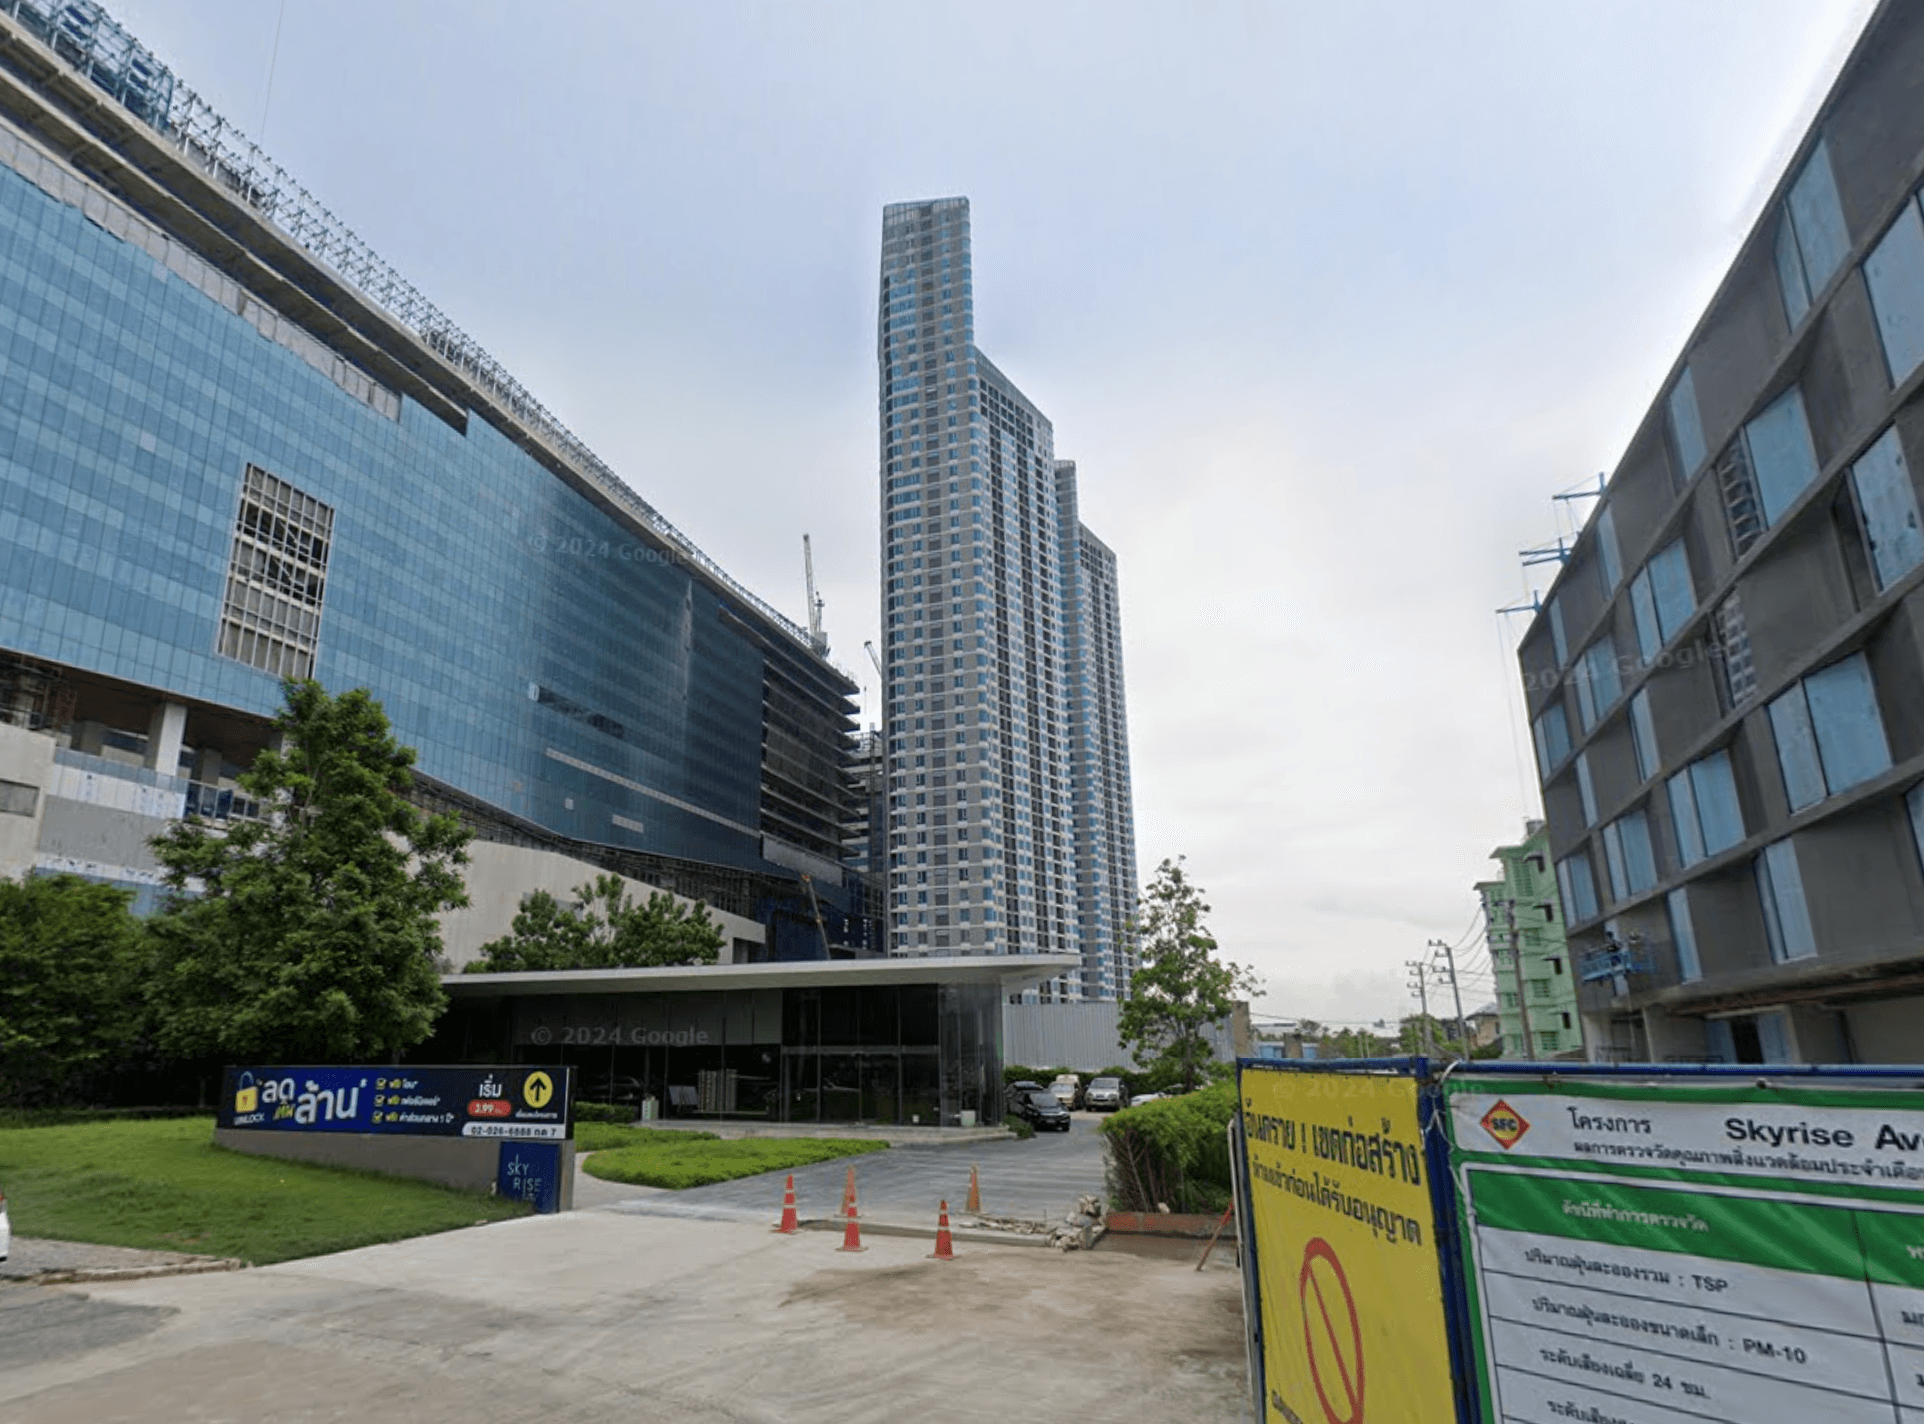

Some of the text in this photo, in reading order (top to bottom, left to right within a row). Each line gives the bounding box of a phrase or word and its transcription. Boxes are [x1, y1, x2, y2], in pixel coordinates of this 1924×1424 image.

[478, 1074, 503, 1098] เริ่ม
[1566, 1105, 1924, 1151] โครงการ Skyrise Av
[1311, 1115, 1422, 1187] เขตก่อสร้าง
[1691, 1274, 1729, 1293] TSP
[1742, 1338, 1808, 1365] PM-10
[1652, 1373, 1673, 1391] 24
